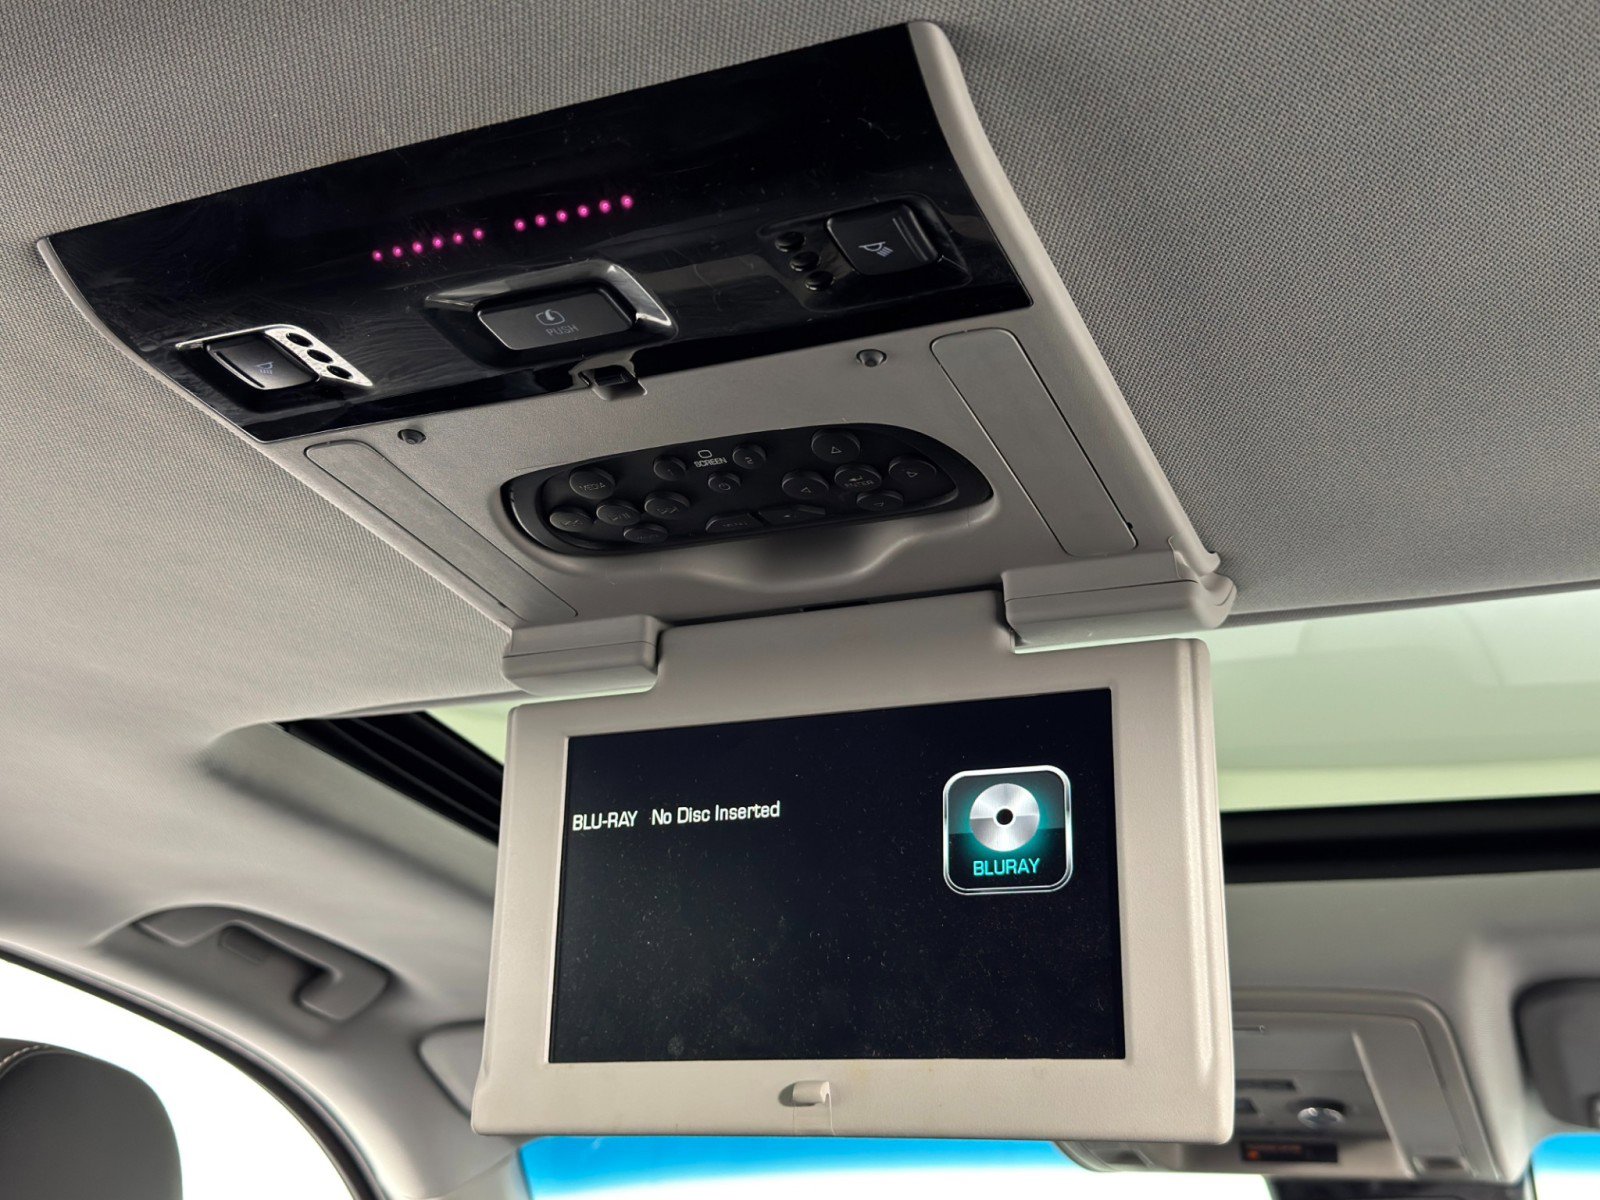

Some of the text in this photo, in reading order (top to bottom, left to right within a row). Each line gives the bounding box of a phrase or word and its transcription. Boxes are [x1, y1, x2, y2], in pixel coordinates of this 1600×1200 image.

[545, 324, 579, 336] PUSH
[694, 457, 728, 469] SCREEN
[572, 800, 781, 831] BLU-RAY No Disc Inserted
[973, 858, 1040, 876] BLURAY
